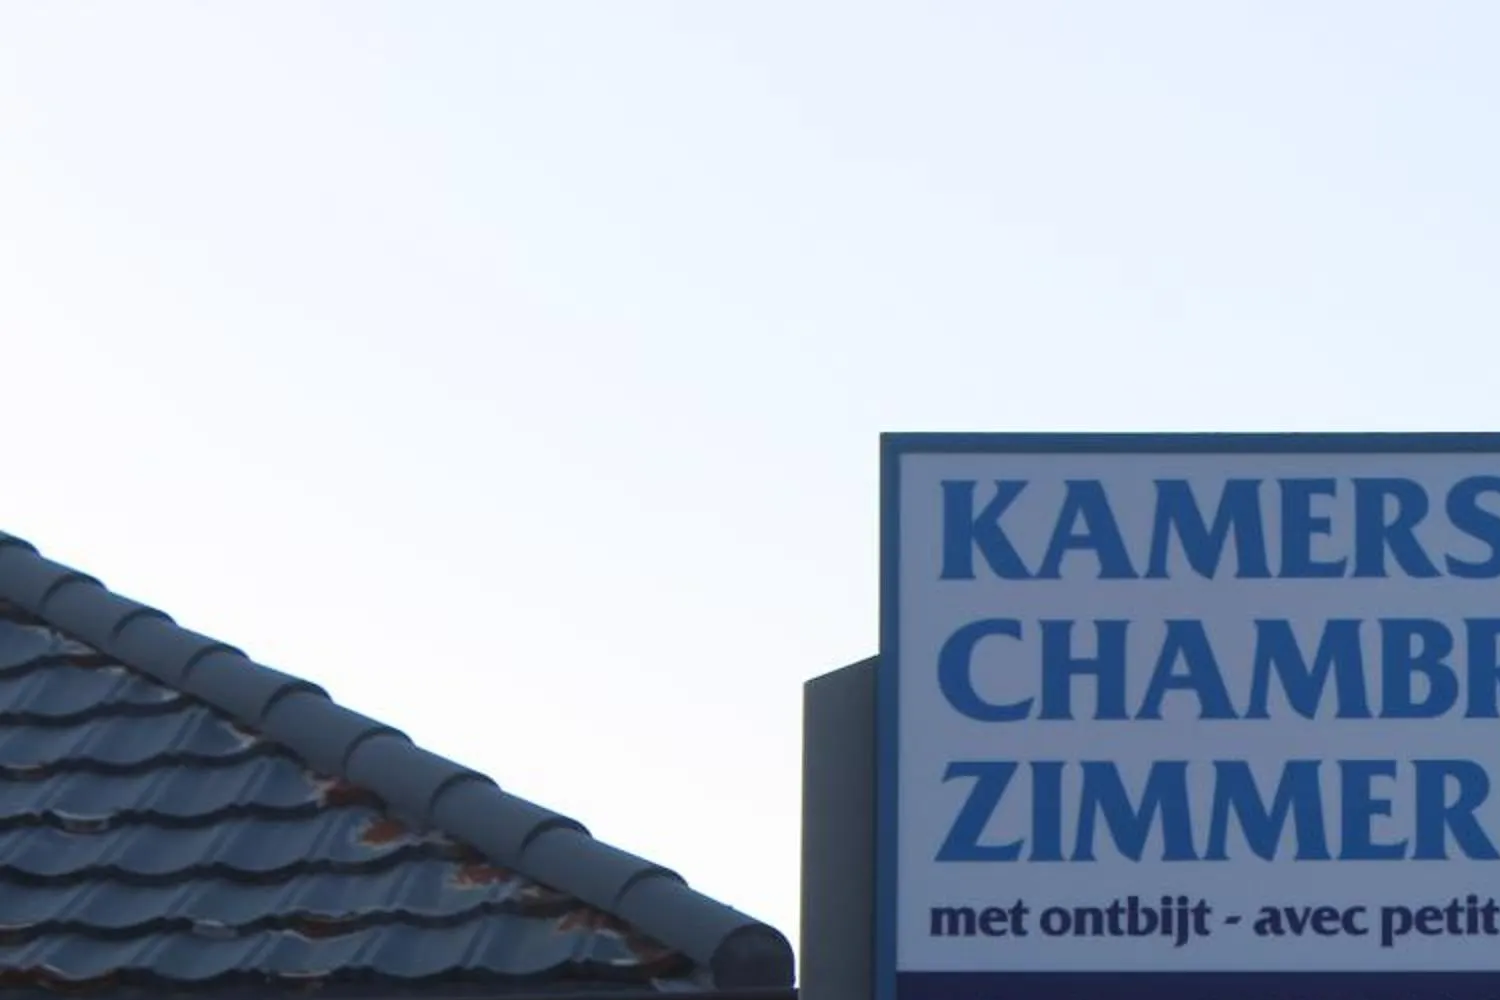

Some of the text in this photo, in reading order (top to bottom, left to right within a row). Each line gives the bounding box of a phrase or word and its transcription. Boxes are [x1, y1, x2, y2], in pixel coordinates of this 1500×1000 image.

[930, 899, 1030, 937] met
[1039, 895, 1212, 947] ontbijt
[1252, 905, 1369, 937] avec
[1380, 894, 1500, 948] petit
